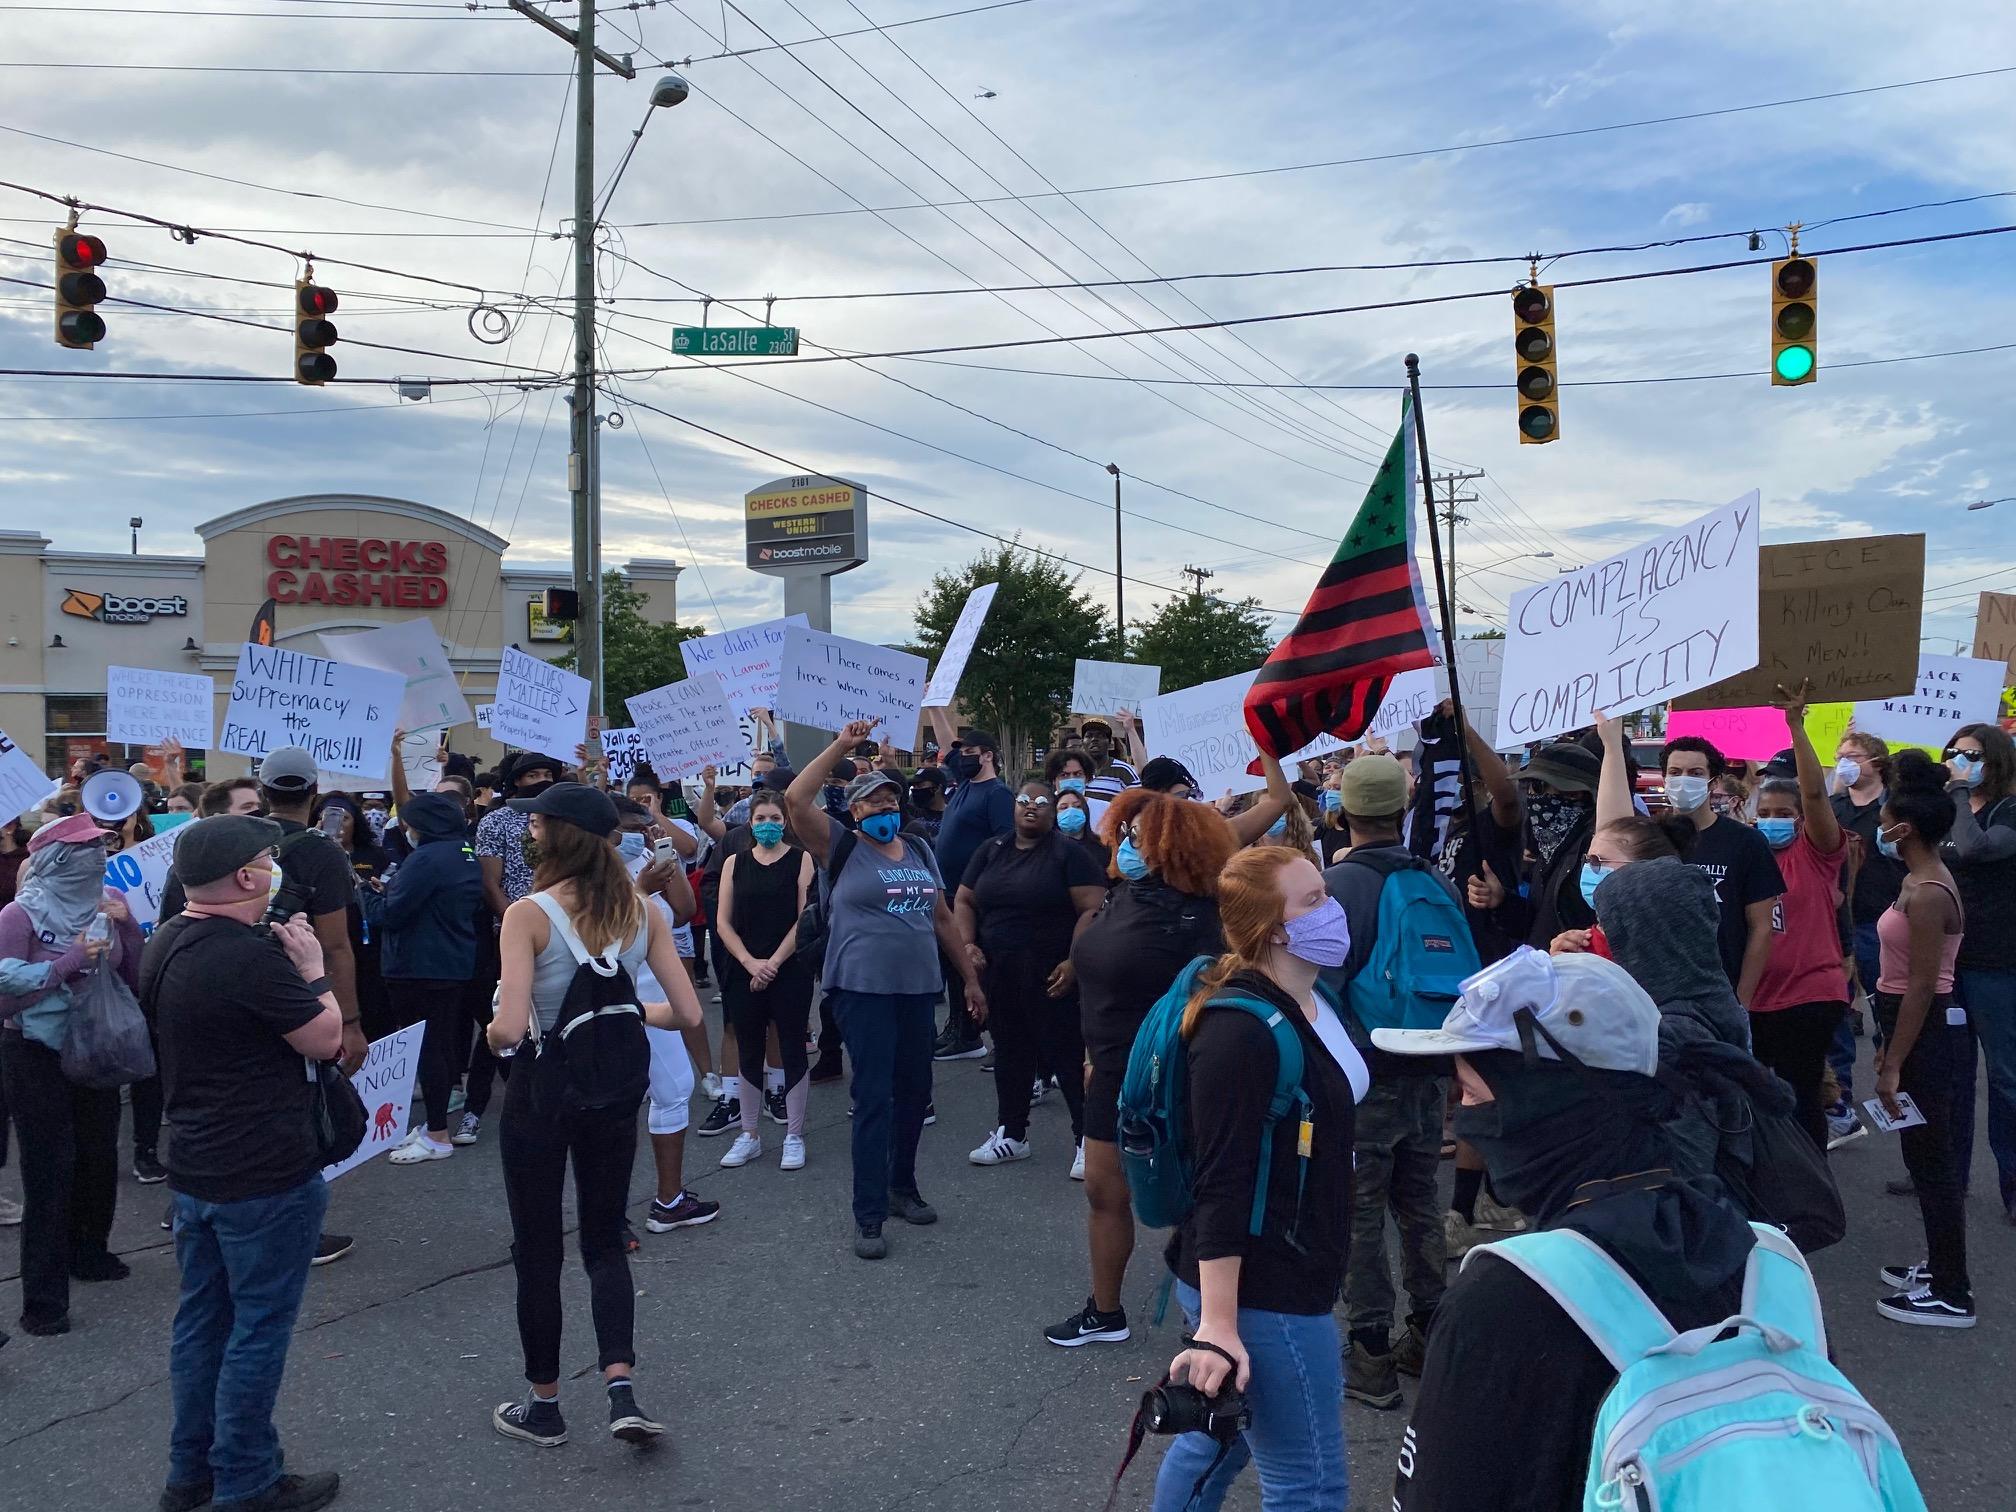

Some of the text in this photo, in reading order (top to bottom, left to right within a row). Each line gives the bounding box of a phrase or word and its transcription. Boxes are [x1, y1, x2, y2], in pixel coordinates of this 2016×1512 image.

[702, 328, 793, 352] LaSalle St
[768, 341, 792, 354] 2300
[749, 491, 851, 511] CHECKS CASHED
[773, 517, 816, 529] WESTERN
[786, 525, 816, 535] UNION
[267, 534, 448, 574] CHECKS
[1769, 544, 1885, 578] LICE
[1518, 504, 1751, 636] COMPLACENCY
[267, 570, 449, 608] CASHED
[104, 593, 187, 616] boost
[1781, 588, 1853, 628] Killing
[105, 612, 150, 623] mobile
[1608, 593, 1661, 656] IS
[686, 640, 717, 663] We
[249, 645, 338, 687] WHITE
[502, 650, 565, 693] BLACK LIVES
[868, 664, 901, 682] comes
[908, 676, 916, 687] a
[1508, 619, 1731, 735] COMPLICITY
[797, 665, 828, 686] time
[837, 678, 869, 698] when
[117, 686, 203, 705] OPPRESSION
[508, 678, 560, 714] MATTER
[282, 712, 311, 731] the
[638, 711, 675, 734] BREATHE
[679, 706, 697, 720] The
[1882, 701, 1962, 720] MATTER
[119, 723, 208, 742] RESISTANCE
[1702, 714, 1748, 733] COPS
[224, 722, 270, 753] REAL
[627, 732, 641, 750] go
[1179, 728, 1258, 777] STRON
[878, 867, 933, 884] LIVING
[906, 886, 919, 895] MY
[887, 896, 933, 916] best life
